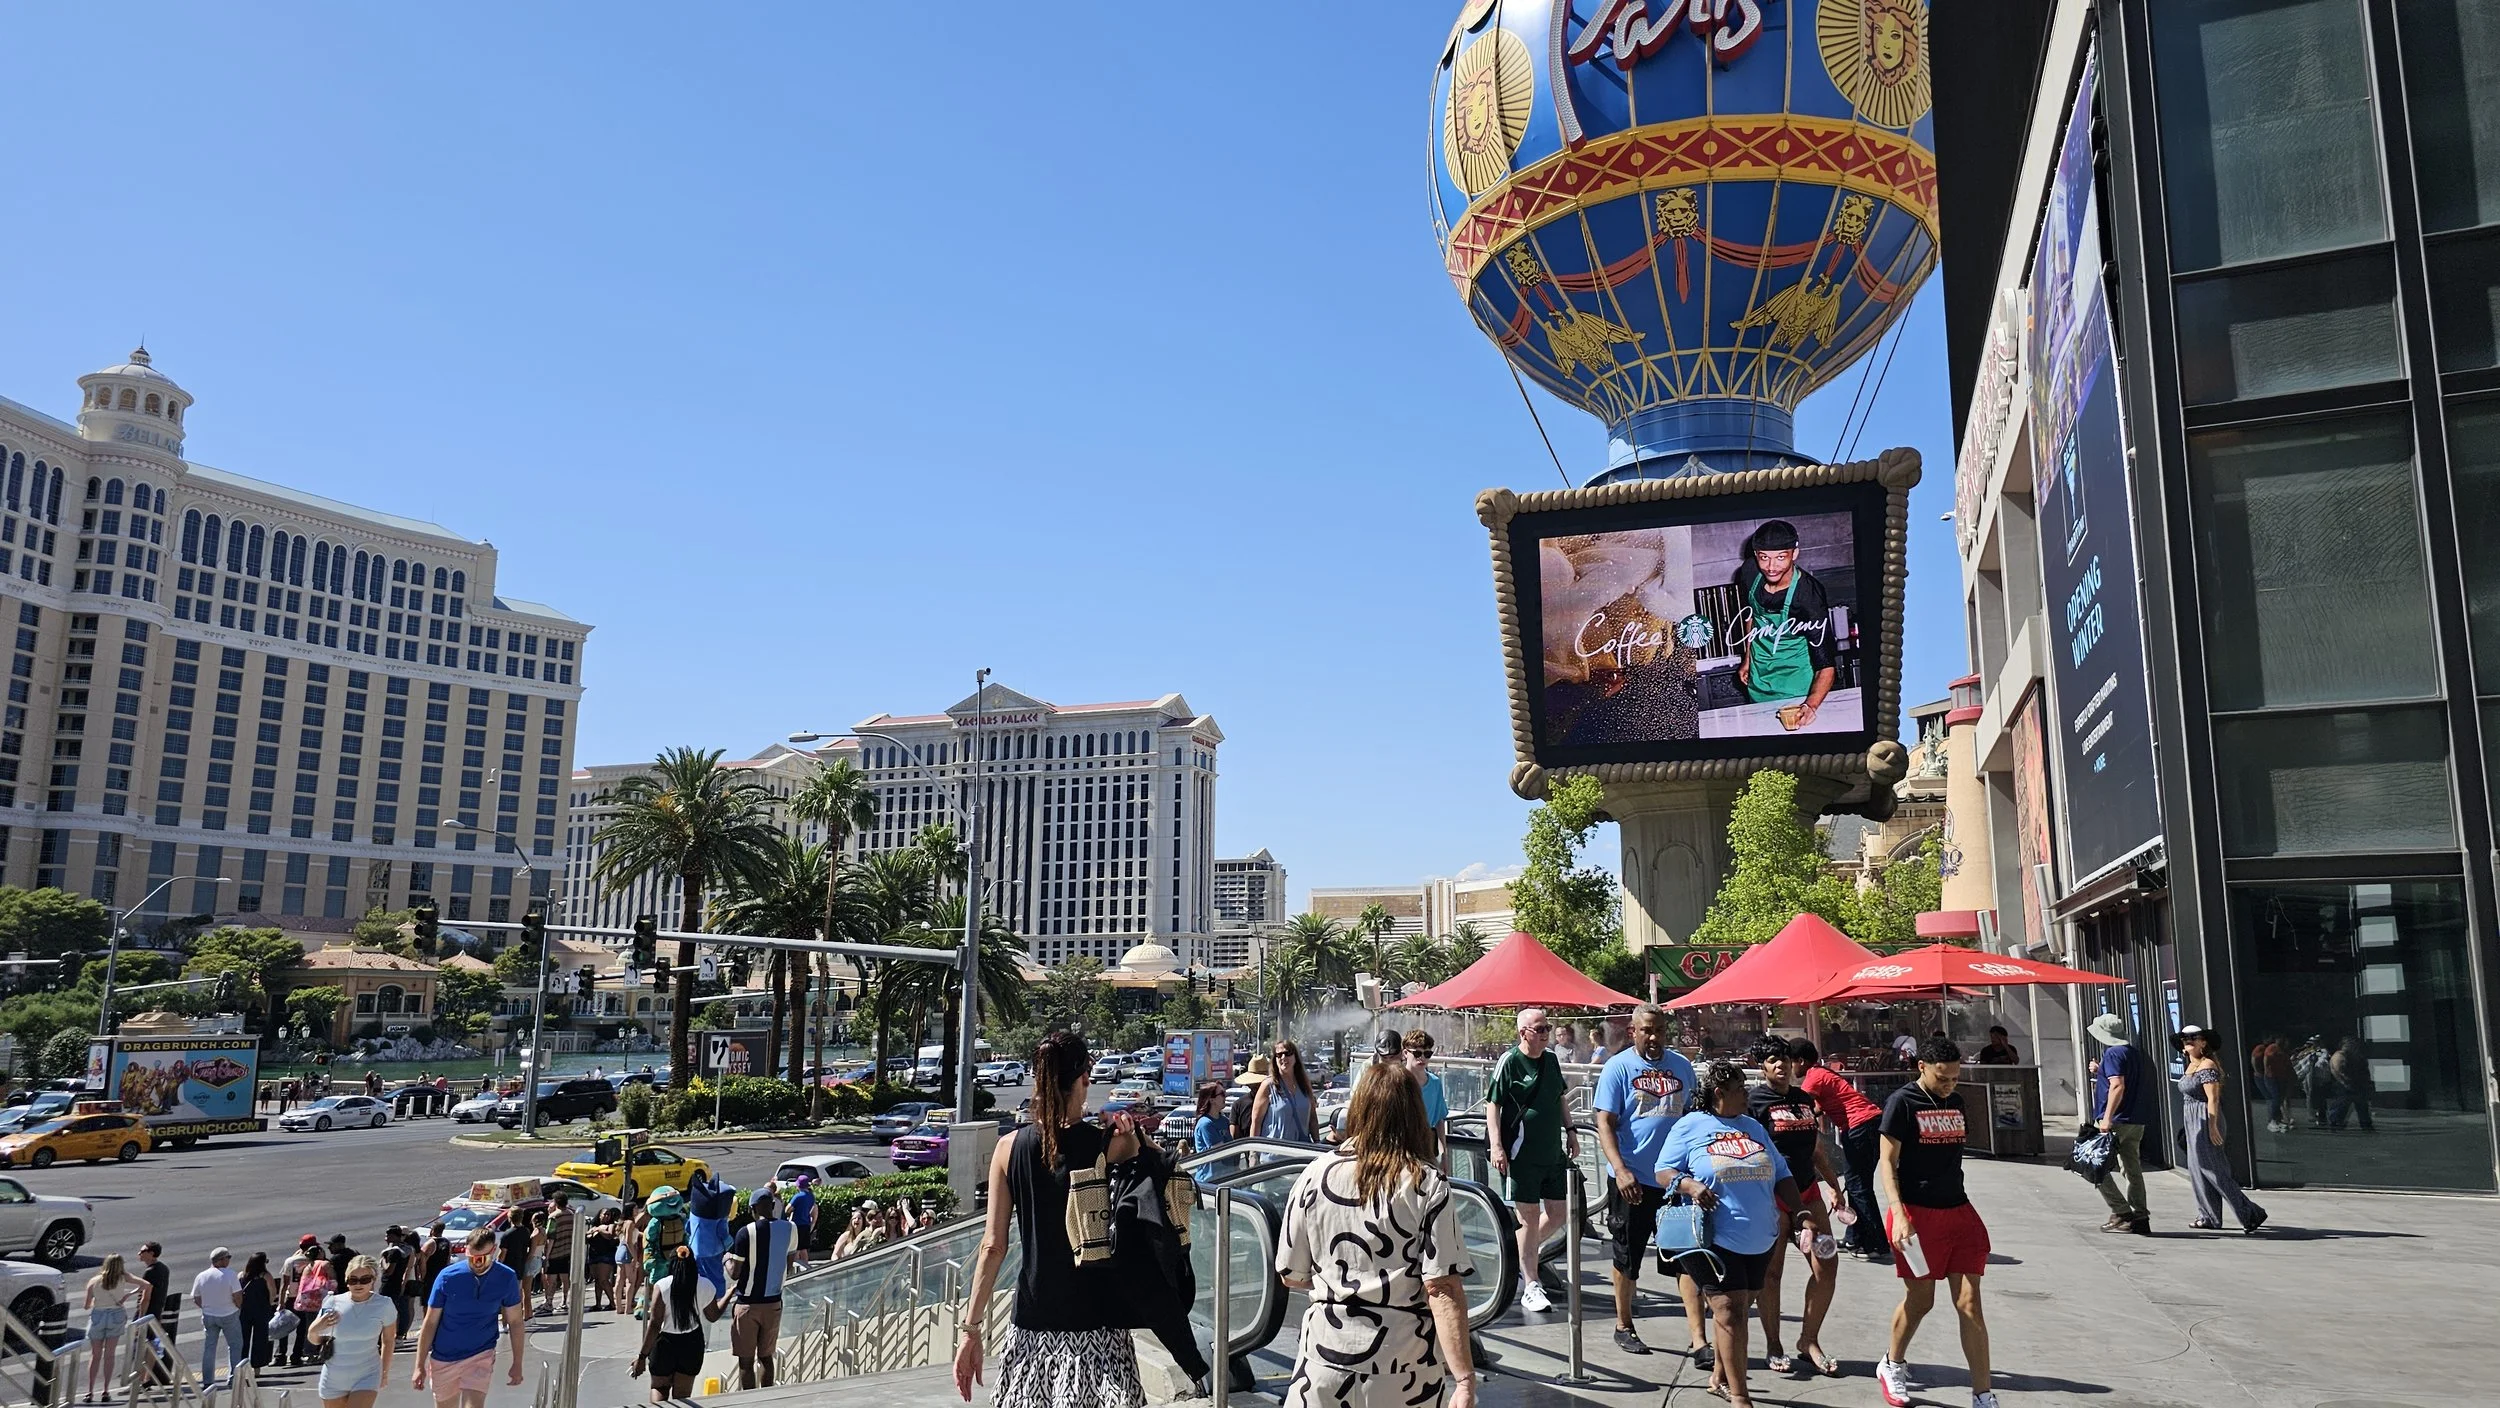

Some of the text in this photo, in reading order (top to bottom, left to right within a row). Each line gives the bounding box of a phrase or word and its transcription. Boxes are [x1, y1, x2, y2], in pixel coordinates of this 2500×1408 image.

[2066, 555, 2101, 633] OPENING
[1574, 606, 1829, 668] Coffee Company
[2071, 602, 2104, 669] WINTER
[1001, 712, 1039, 724] PALACE
[1679, 950, 1742, 981] CA
[123, 1041, 251, 1051] DRAGBRUNCH.COM
[730, 1050, 750, 1062] OMIC
[1637, 1076, 1679, 1093] VEGAS TRIP
[148, 1121, 260, 1137] AGBRUNCH.COM
[1711, 1139, 1743, 1155] VEGAS
[1088, 1209, 1111, 1222] TO
